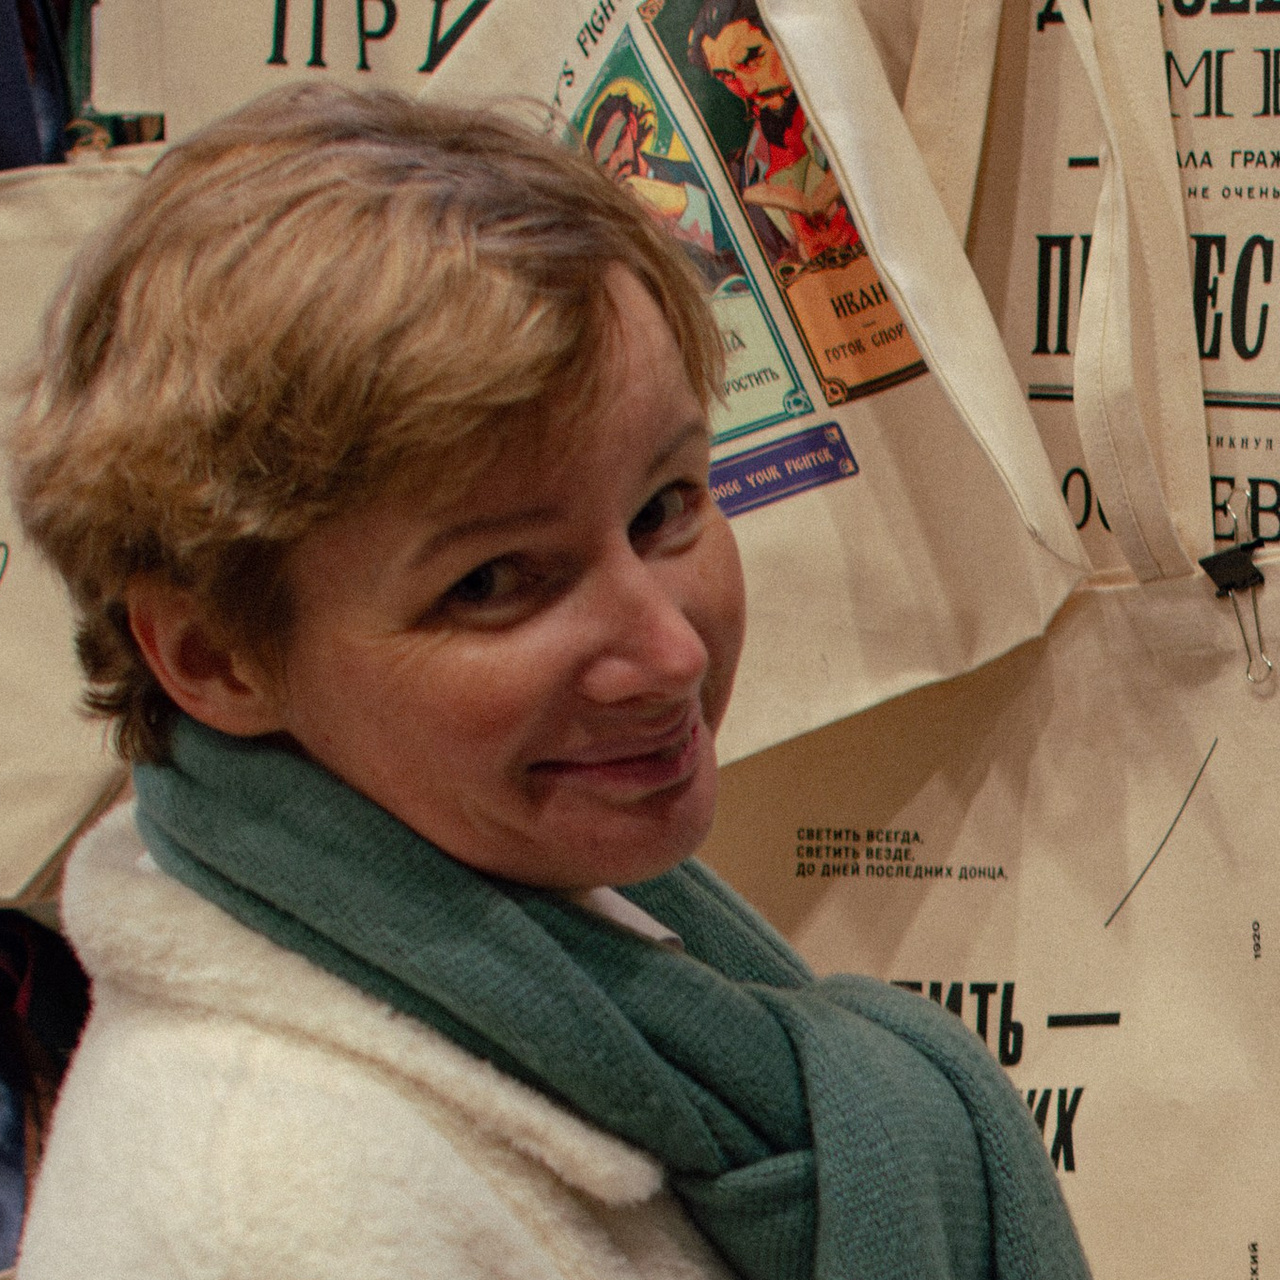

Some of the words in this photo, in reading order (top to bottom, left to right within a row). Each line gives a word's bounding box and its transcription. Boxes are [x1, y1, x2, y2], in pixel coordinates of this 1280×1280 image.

[576, 0, 619, 57] FIGH
[1188, 186, 1209, 198] НЕ
[1222, 186, 1280, 198] ОЧЕНЬ
[830, 281, 889, 319] ИВАН
[722, 367, 779, 397] РОСТИТЬ
[1206, 435, 1274, 451] ИКНУЛ
[711, 477, 743, 499] OOSE
[745, 464, 783, 489] YOUR
[797, 828, 861, 842] СВЕТИТЬ
[866, 829, 924, 844] ВСЕГДА,
[796, 845, 860, 860] СВЕТИТЬ
[796, 863, 816, 877] ДО
[821, 862, 860, 877] ДНЕЙ
[865, 864, 953, 879] ПОСЛЕДНИХ
[1252, 919, 1261, 959] 1920
